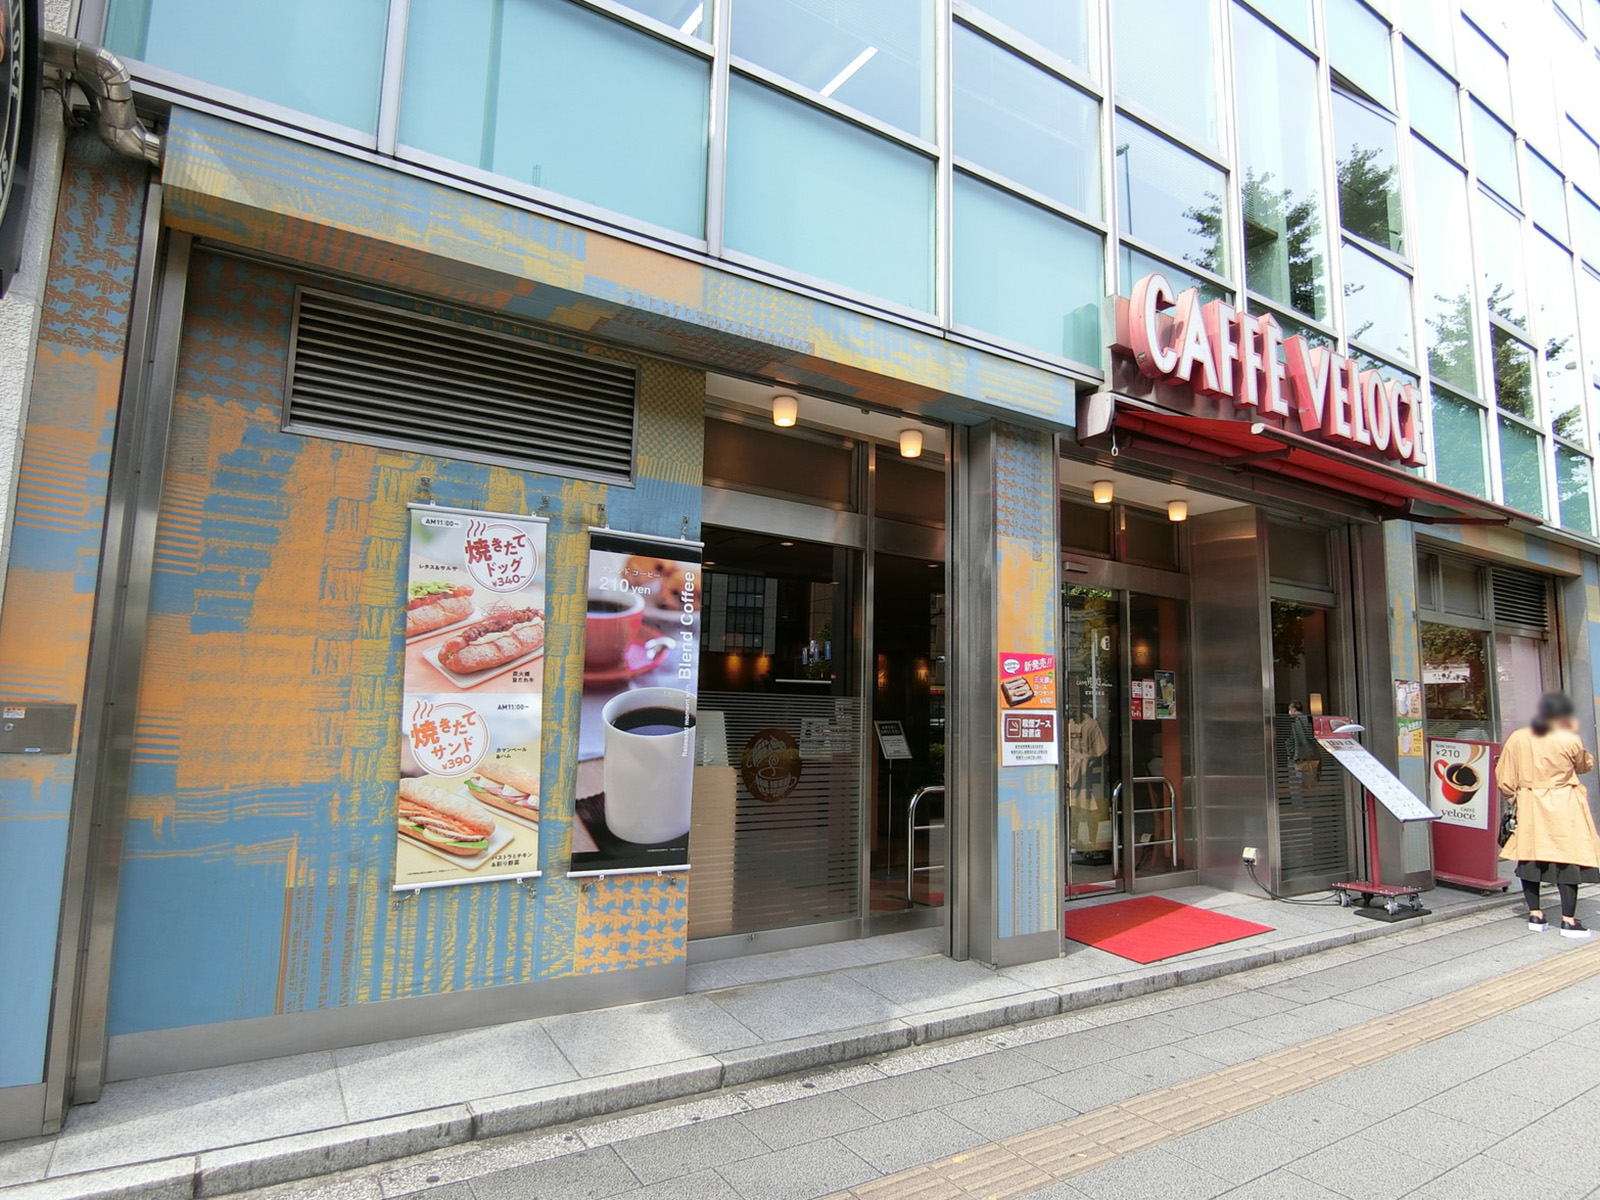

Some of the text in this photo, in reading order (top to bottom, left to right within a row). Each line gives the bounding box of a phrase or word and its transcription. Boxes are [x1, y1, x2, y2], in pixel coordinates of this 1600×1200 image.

[1295, 334, 1427, 467] VELOCE
[464, 533, 526, 565] 焼きたて
[486, 556, 523, 577] ドッグ
[599, 576, 651, 595] 210 yen
[677, 571, 696, 681] Blend Coffee
[410, 711, 477, 749] 焼きたて
[431, 736, 473, 760] サンド
[1435, 748, 1460, 758] ¥210
[442, 755, 472, 770] ¥390
[1441, 808, 1477, 821] veloce
